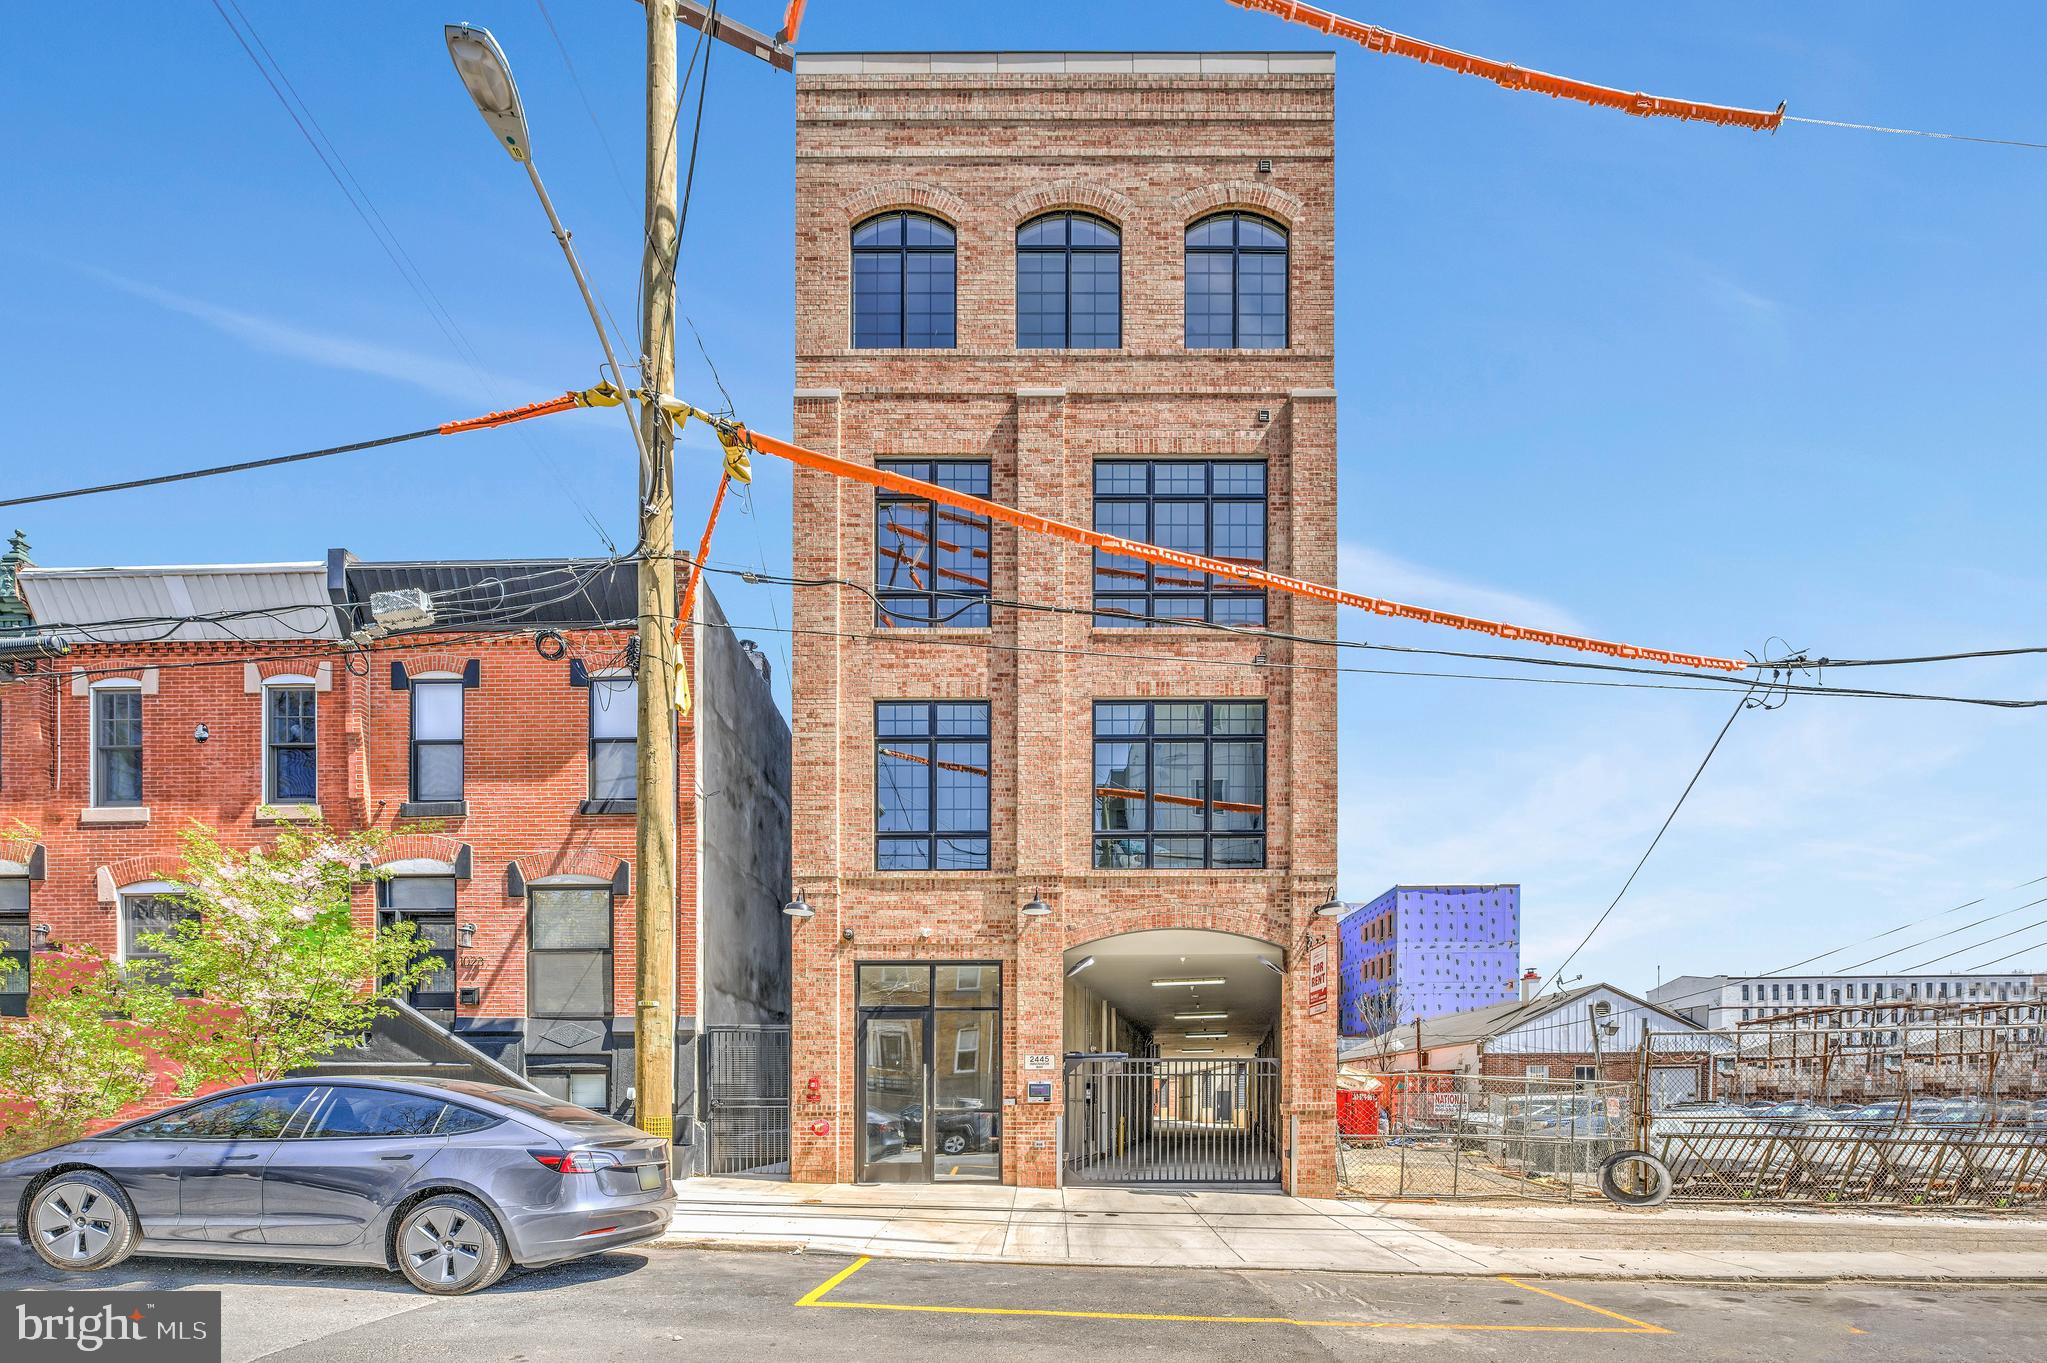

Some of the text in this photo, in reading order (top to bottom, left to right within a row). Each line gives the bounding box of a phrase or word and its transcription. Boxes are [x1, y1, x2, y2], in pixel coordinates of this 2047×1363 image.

[1313, 961, 1324, 975] FOR
[1311, 973, 1325, 987] RENT
[1029, 1055, 1050, 1063] 2445
